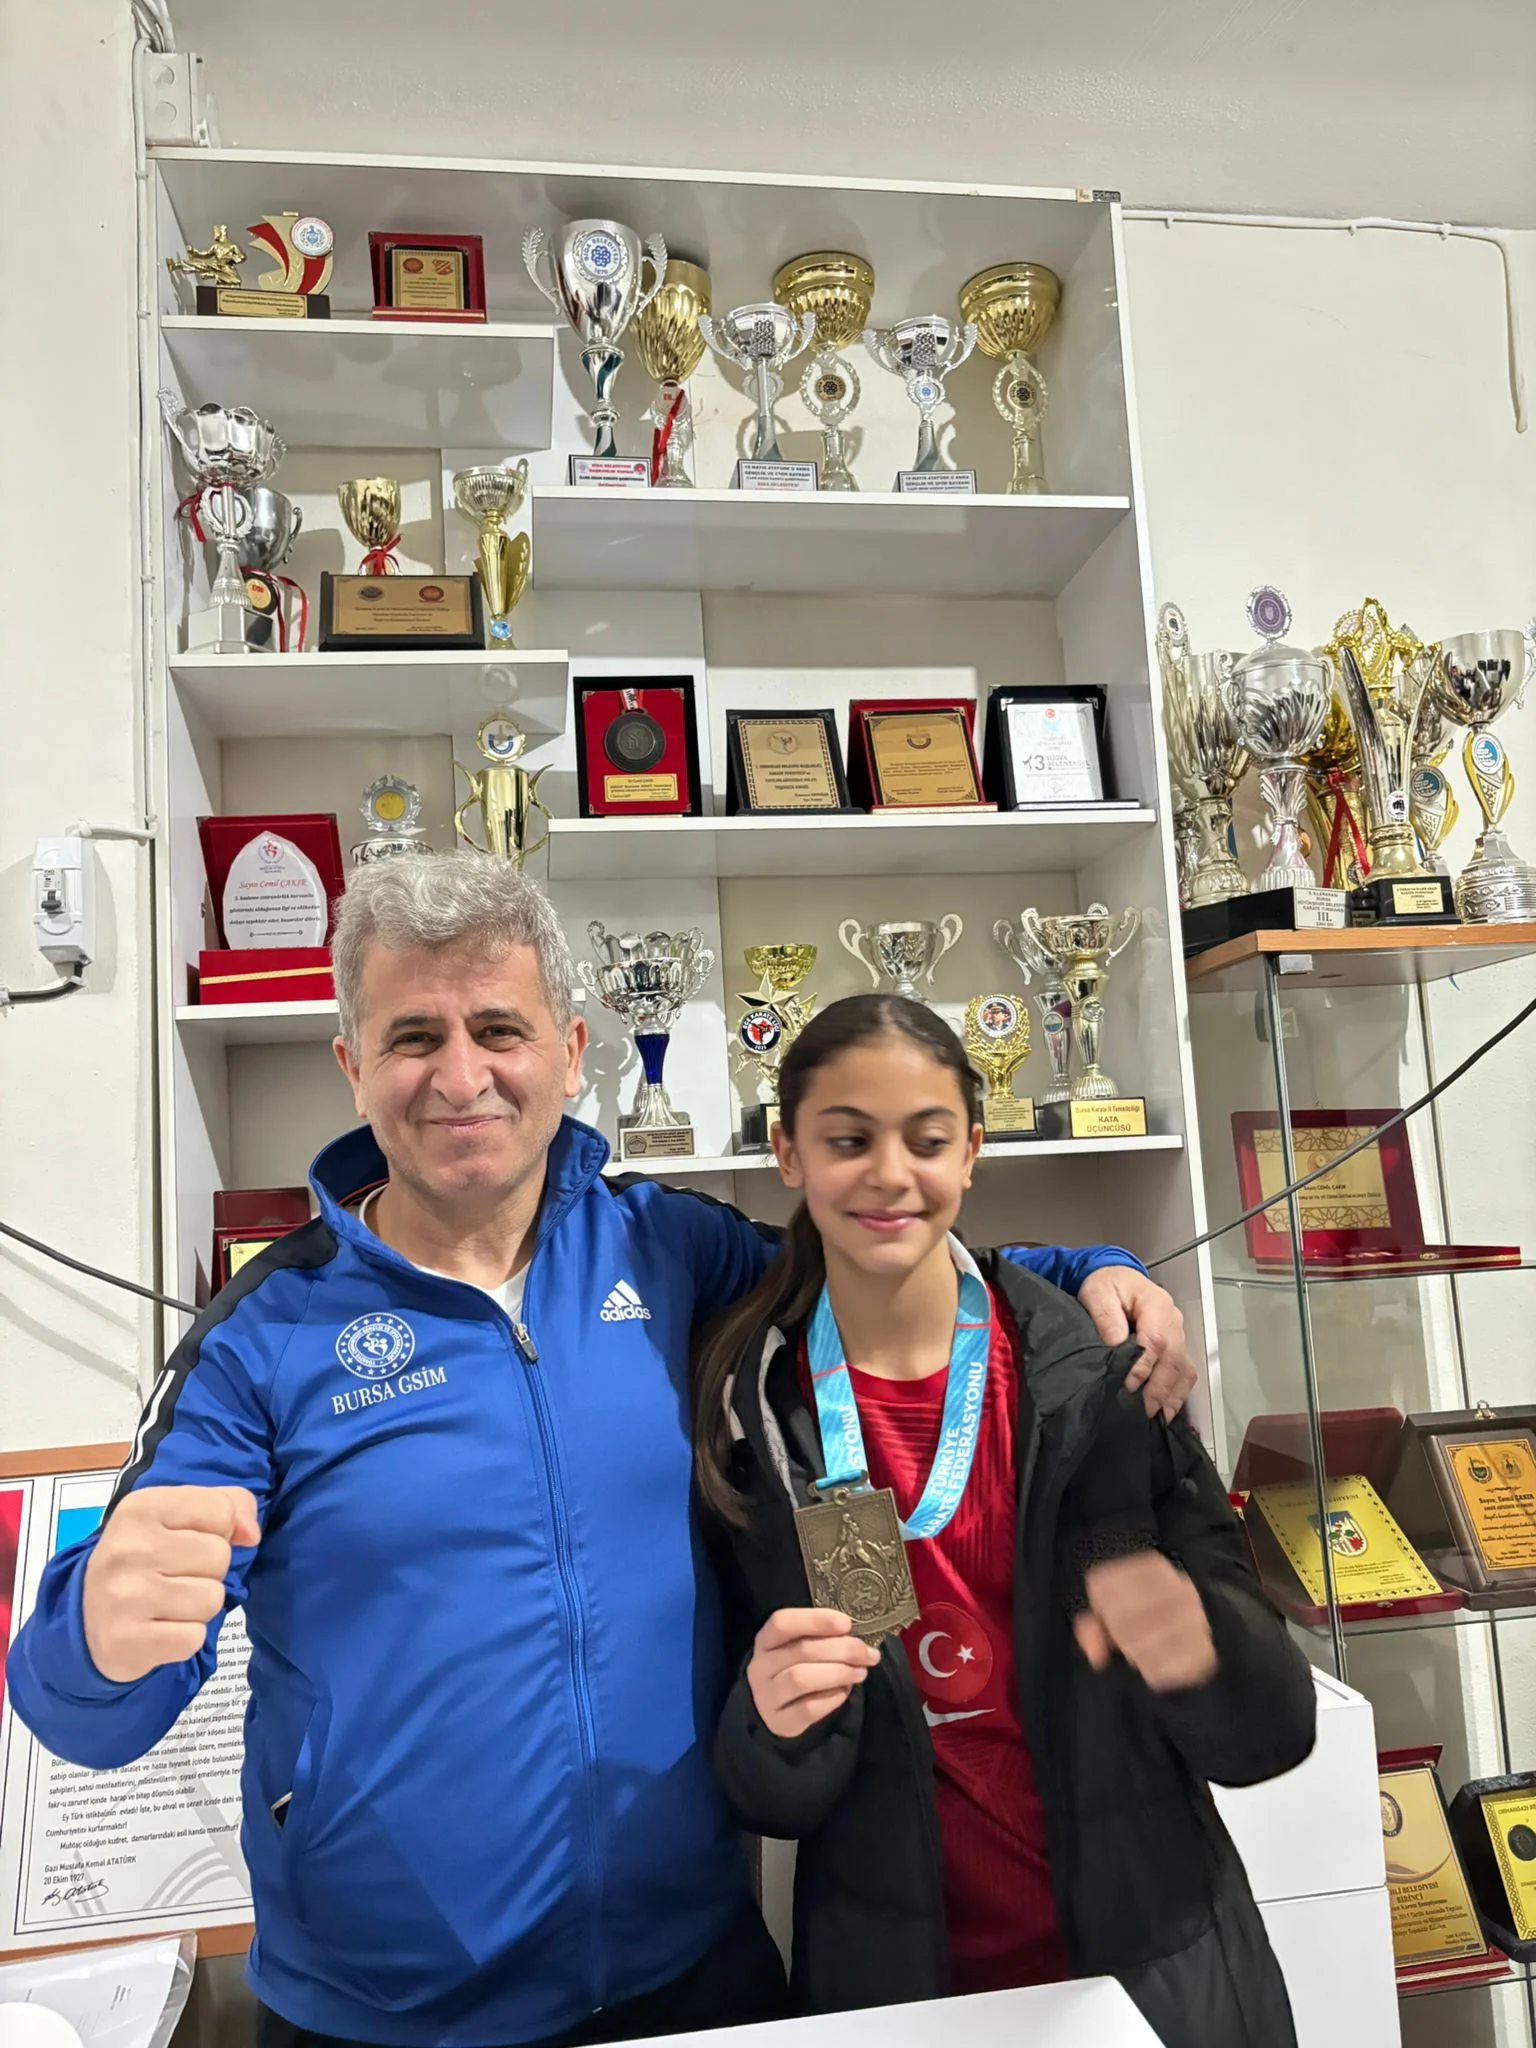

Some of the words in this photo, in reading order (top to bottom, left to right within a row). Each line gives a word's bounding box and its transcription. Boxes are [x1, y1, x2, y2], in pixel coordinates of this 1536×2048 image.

[1086, 1124, 1131, 1134] ÜÇÜNCÜSÜ
[600, 1304, 651, 1321] adidas
[332, 1381, 396, 1415] BURSA
[398, 1366, 448, 1394] GSİM
[948, 1361, 984, 1492] FEDERASYONU
[928, 1426, 960, 1497] TÜRKİYE
[62, 1814, 69, 1822] Ey
[71, 1812, 84, 1820] Türk
[82, 1838, 107, 1848] olduğun
[44, 1864, 58, 1873] Gazi
[60, 1862, 85, 1871] Mustafa
[86, 1859, 106, 1868] Kemal
[106, 1855, 137, 1866] ATATÜRK
[44, 1877, 52, 1885] 20
[52, 1875, 68, 1884] Ekim
[70, 1873, 85, 1882] 1927
[1396, 1892, 1424, 1904] BİRİNCİ
